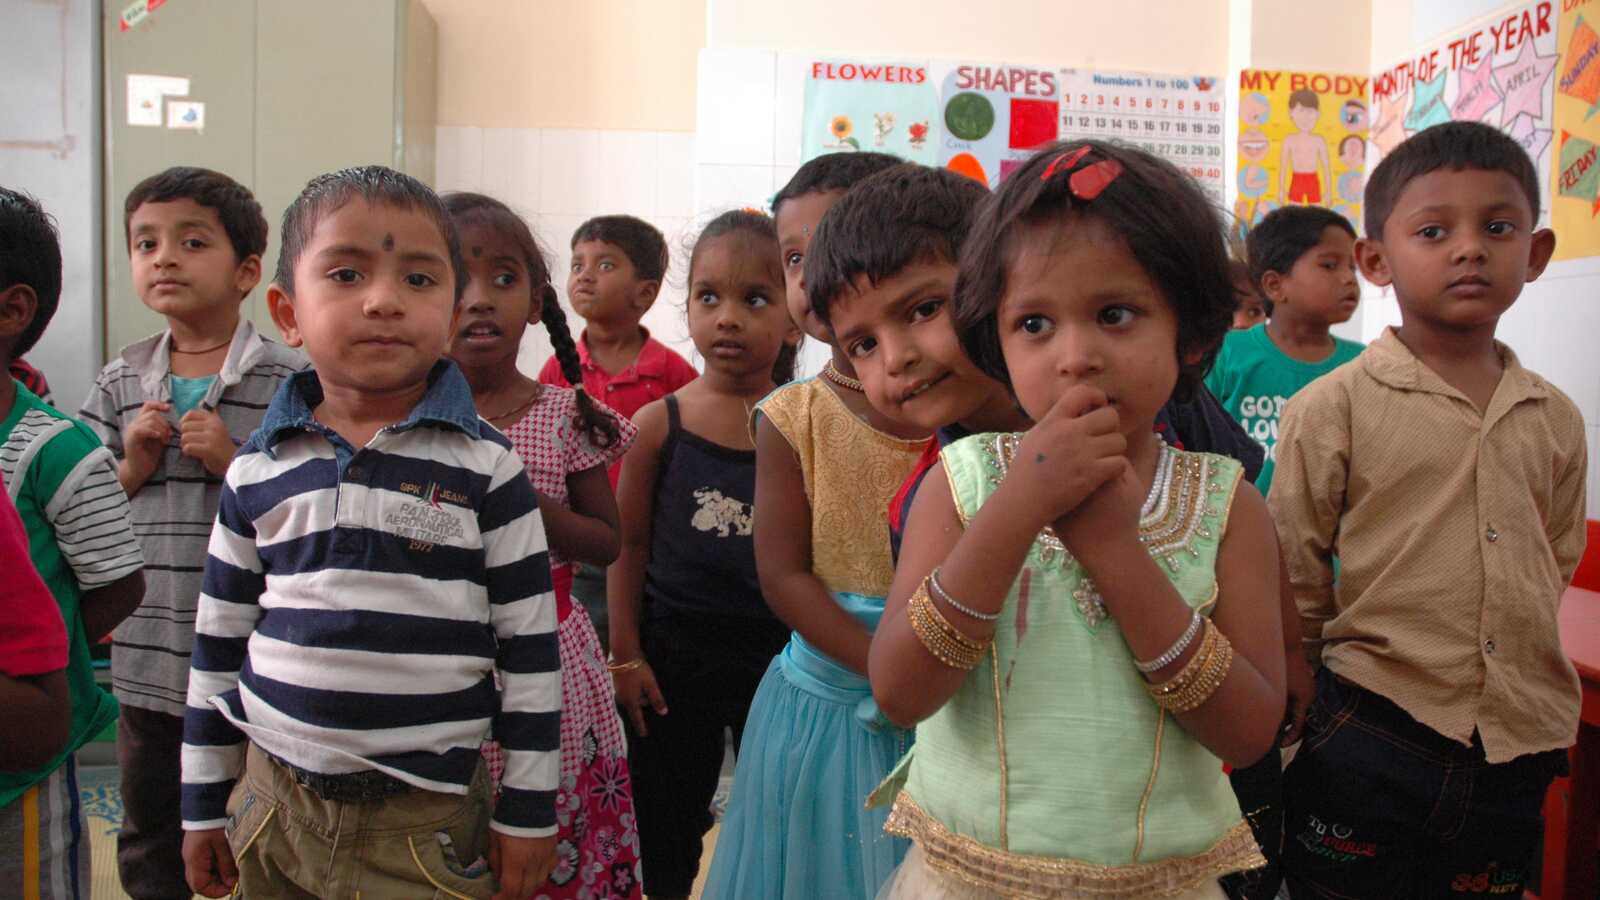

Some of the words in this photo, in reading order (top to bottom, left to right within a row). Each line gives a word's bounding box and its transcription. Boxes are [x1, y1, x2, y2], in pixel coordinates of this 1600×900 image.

[1373, 60, 1415, 104] MONTH
[1418, 51, 1439, 82] OF
[1448, 31, 1483, 70] THE
[1490, 2, 1551, 54] YEAR
[812, 62, 926, 83] FLOWERS
[955, 66, 1056, 96] SHAPES
[1094, 74, 1143, 87] Numbers
[1155, 79, 1167, 89] to
[1171, 79, 1189, 90] 100
[1506, 64, 1540, 92] APRIL
[1240, 70, 1281, 91] MY
[1290, 73, 1369, 97] BODY
[1081, 94, 1088, 105] 2
[1098, 94, 1104, 106] 3
[1113, 96, 1120, 107] 4
[1129, 97, 1136, 108] 5
[1145, 98, 1152, 109] 6
[1161, 98, 1168, 109] 7
[1177, 100, 1184, 111] 8
[1193, 101, 1200, 112] 9
[1208, 102, 1220, 113] 10
[1063, 115, 1073, 127] 11
[1079, 116, 1090, 128] 12
[1095, 117, 1106, 129] 13
[1112, 119, 1122, 129] 14
[1128, 120, 1139, 130] 15
[1144, 120, 1155, 131] 16
[1160, 121, 1170, 132] 17
[1176, 122, 1187, 133] 18
[1192, 123, 1203, 134] 19
[1207, 124, 1220, 135] 20
[1191, 145, 1203, 156] 29
[1207, 146, 1220, 157] 30
[1207, 167, 1220, 178] 40
[1559, 144, 1597, 195] FRIDAY
